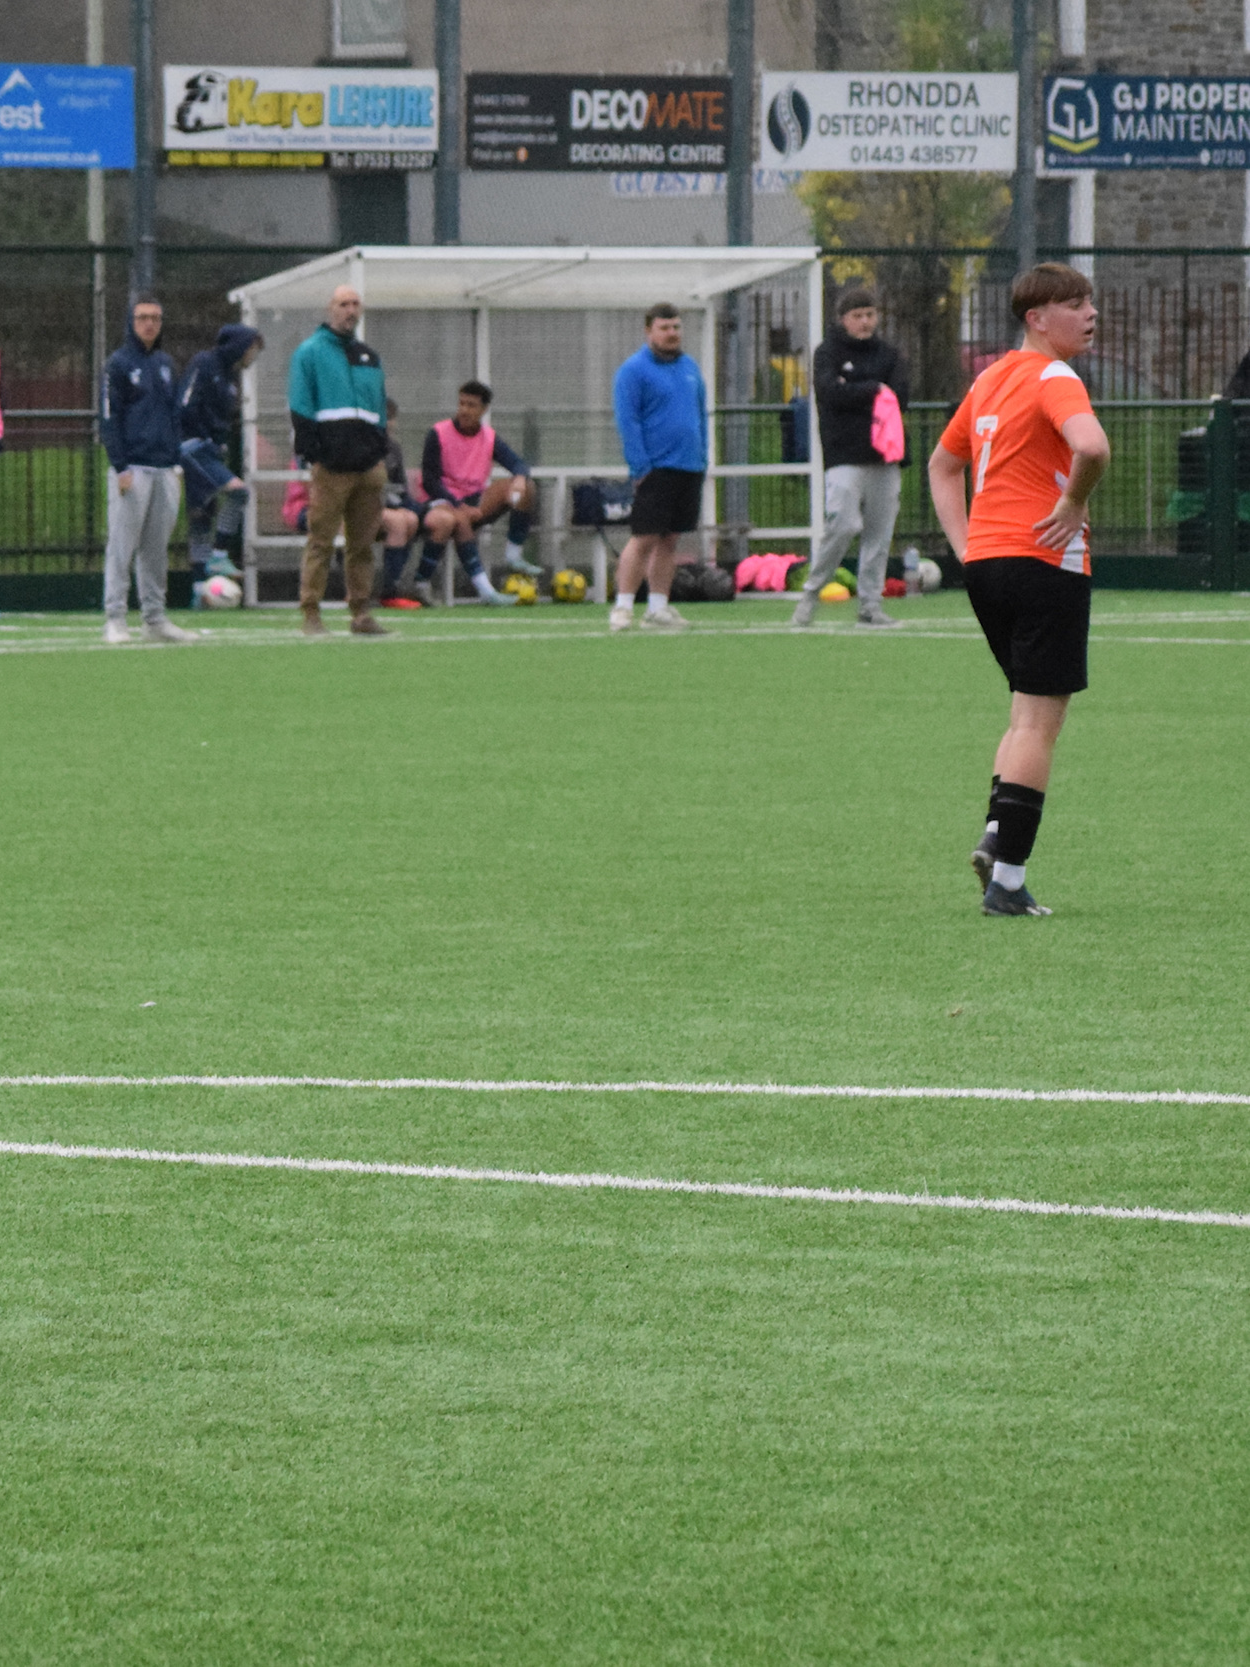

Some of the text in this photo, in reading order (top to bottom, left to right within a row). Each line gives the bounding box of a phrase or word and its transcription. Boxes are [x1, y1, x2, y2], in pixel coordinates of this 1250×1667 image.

[227, 77, 434, 129] Kara LEISURE
[848, 81, 981, 108] RHONDDA
[1112, 82, 1149, 112] GJ
[570, 88, 725, 132] DECOMATE
[817, 114, 1012, 138] OSTEOPATHIC CLINIC
[569, 143, 726, 165] DECORATING CENTRE
[850, 145, 978, 164] 01443 438577
[975, 414, 999, 494] 7
